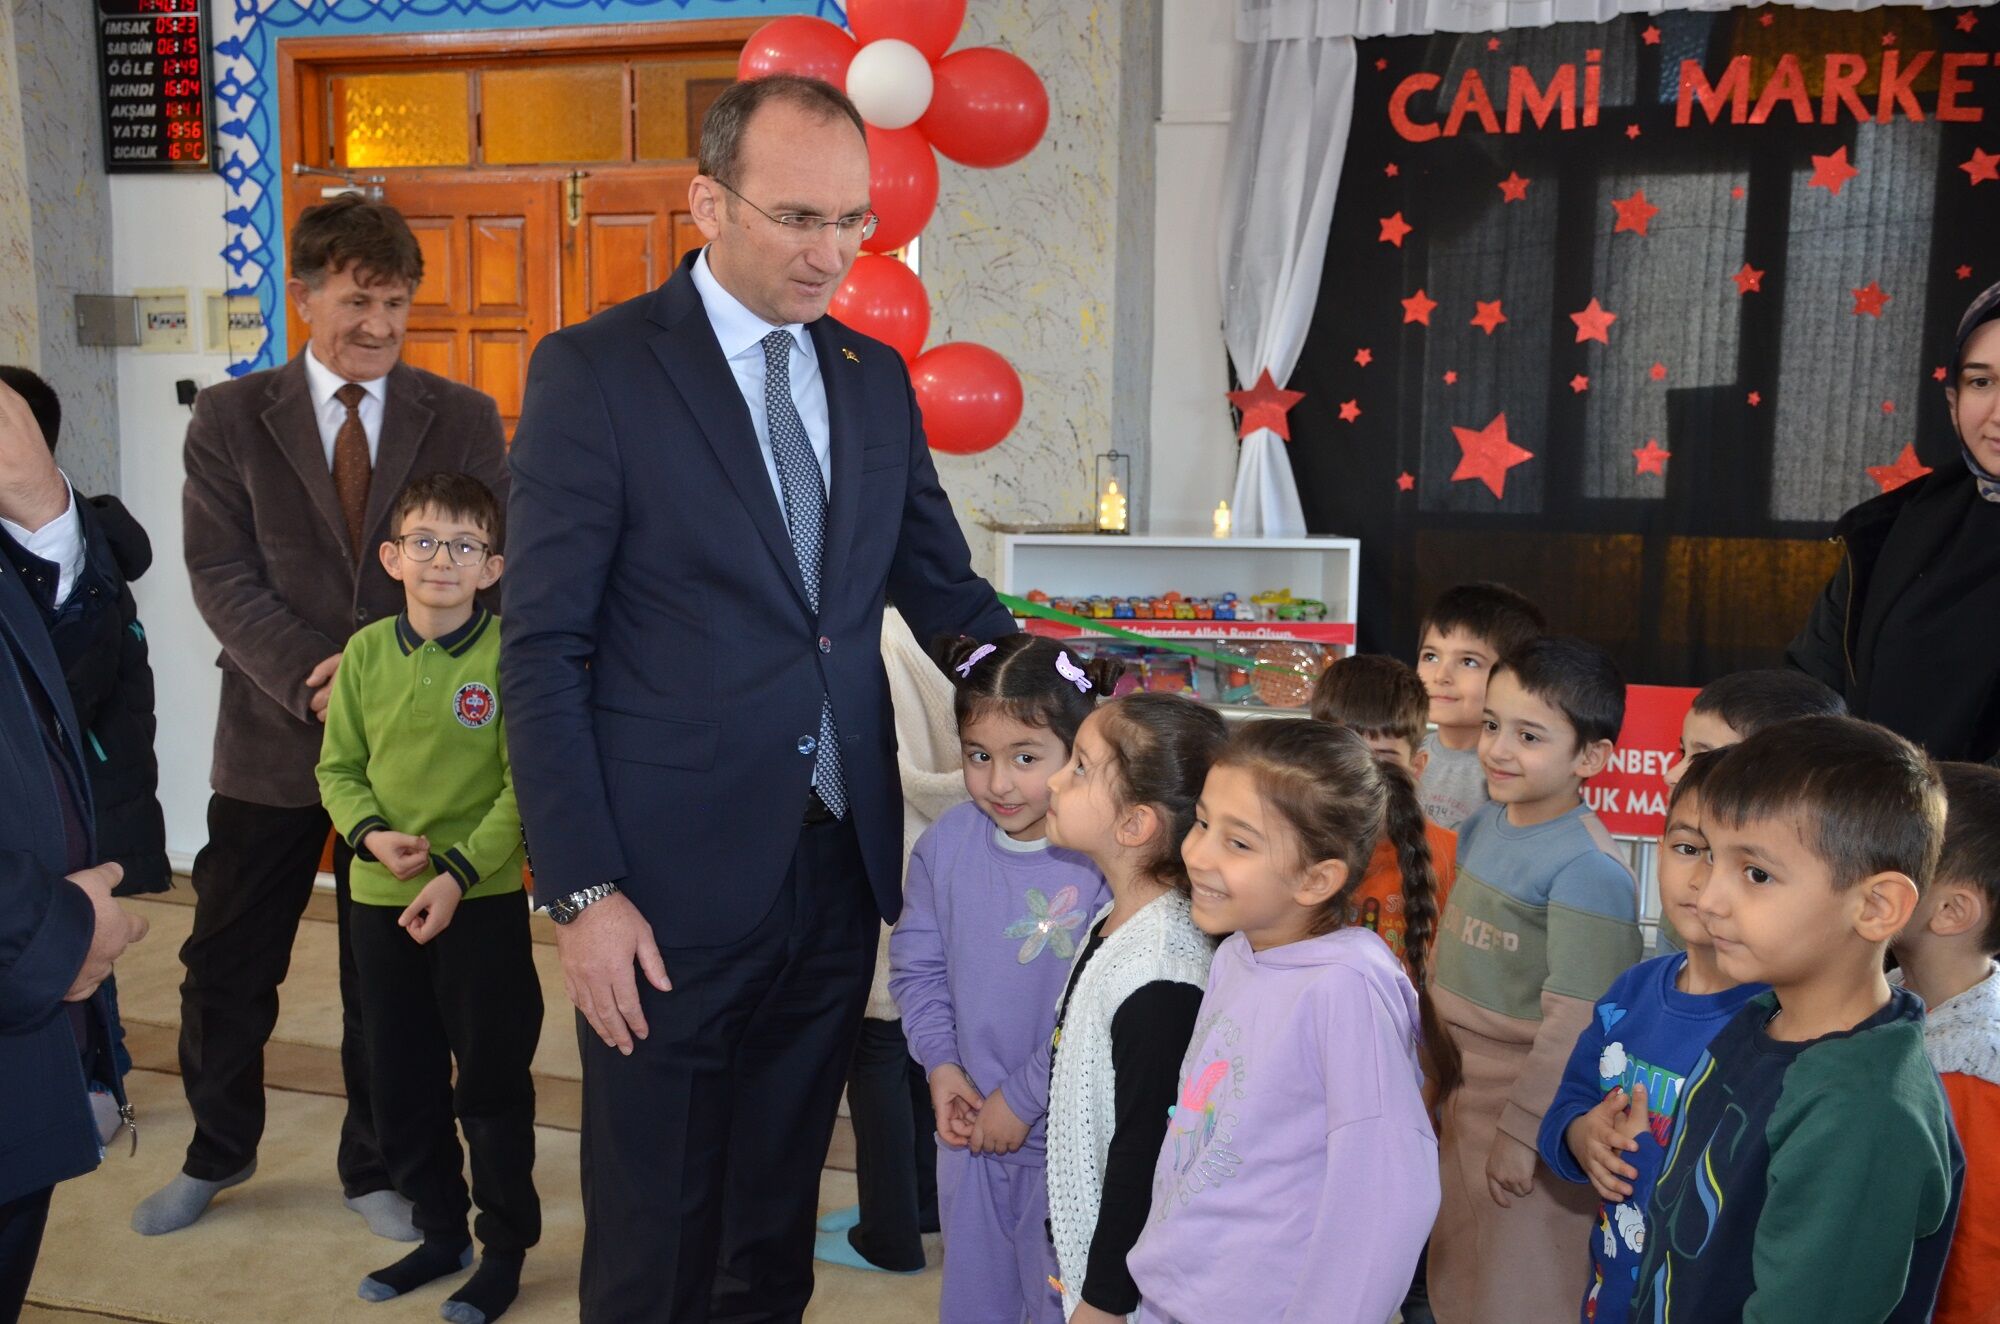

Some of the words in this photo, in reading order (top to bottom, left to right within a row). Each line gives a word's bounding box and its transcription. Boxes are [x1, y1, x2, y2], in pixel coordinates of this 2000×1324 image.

[156, 16, 197, 34] 05:23
[157, 37, 198, 55] 06:15
[108, 59, 154, 76] ÖĞLE
[163, 58, 199, 76] 12:49
[164, 79, 200, 97] 16:04
[1675, 50, 2000, 128] MARKE
[110, 103, 157, 120] AKŞAM
[113, 124, 157, 138] YATSI
[167, 121, 202, 139] 19:56
[113, 145, 158, 159] SICAKLIK
[1607, 749, 1675, 775] NBEY
[1579, 786, 1620, 813] UK
[1626, 789, 1668, 817] MA
